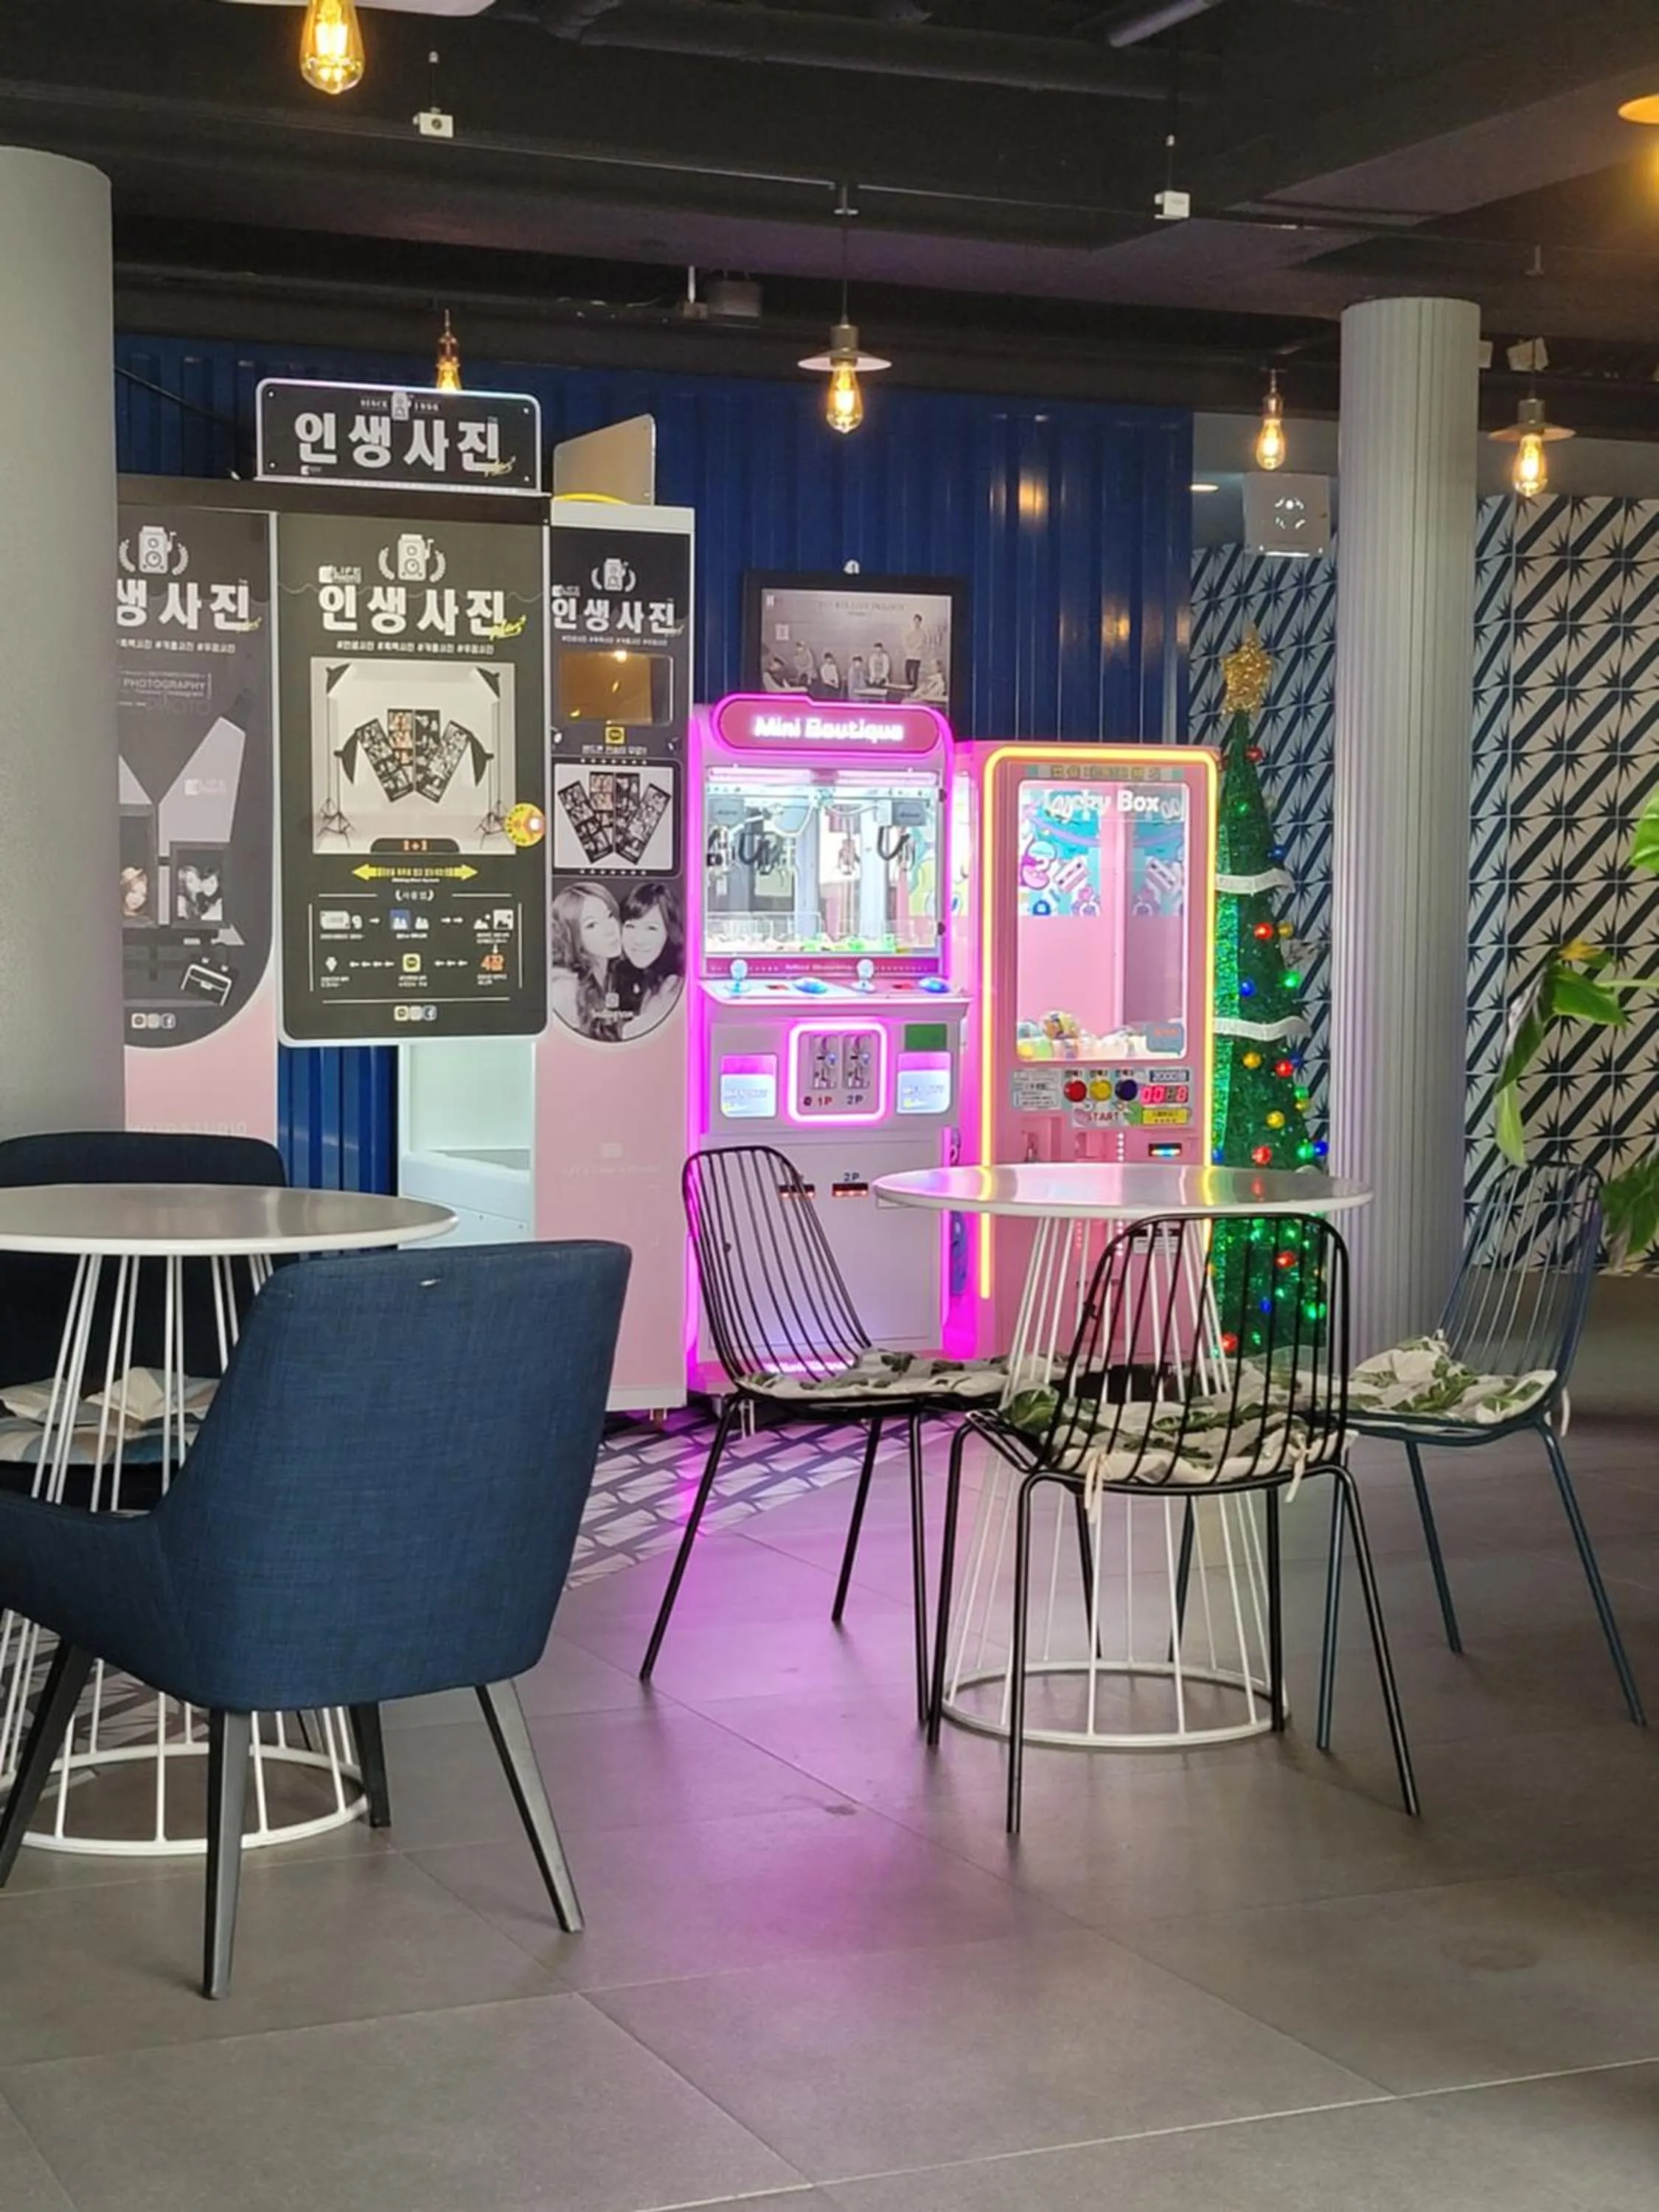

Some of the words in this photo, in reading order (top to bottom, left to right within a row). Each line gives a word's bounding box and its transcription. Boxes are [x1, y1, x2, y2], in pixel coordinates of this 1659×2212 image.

[295, 412, 499, 472] 인생사진
[116, 579, 249, 631] 생사진
[319, 585, 504, 636] 인생사진
[552, 597, 675, 634] 인생사진
[754, 715, 801, 737] Mini
[804, 717, 904, 743] Boutique
[1116, 790, 1160, 812] Box
[846, 1094, 863, 1105] 2P
[1088, 1112, 1119, 1121] START
[844, 1172, 860, 1181] 2P
